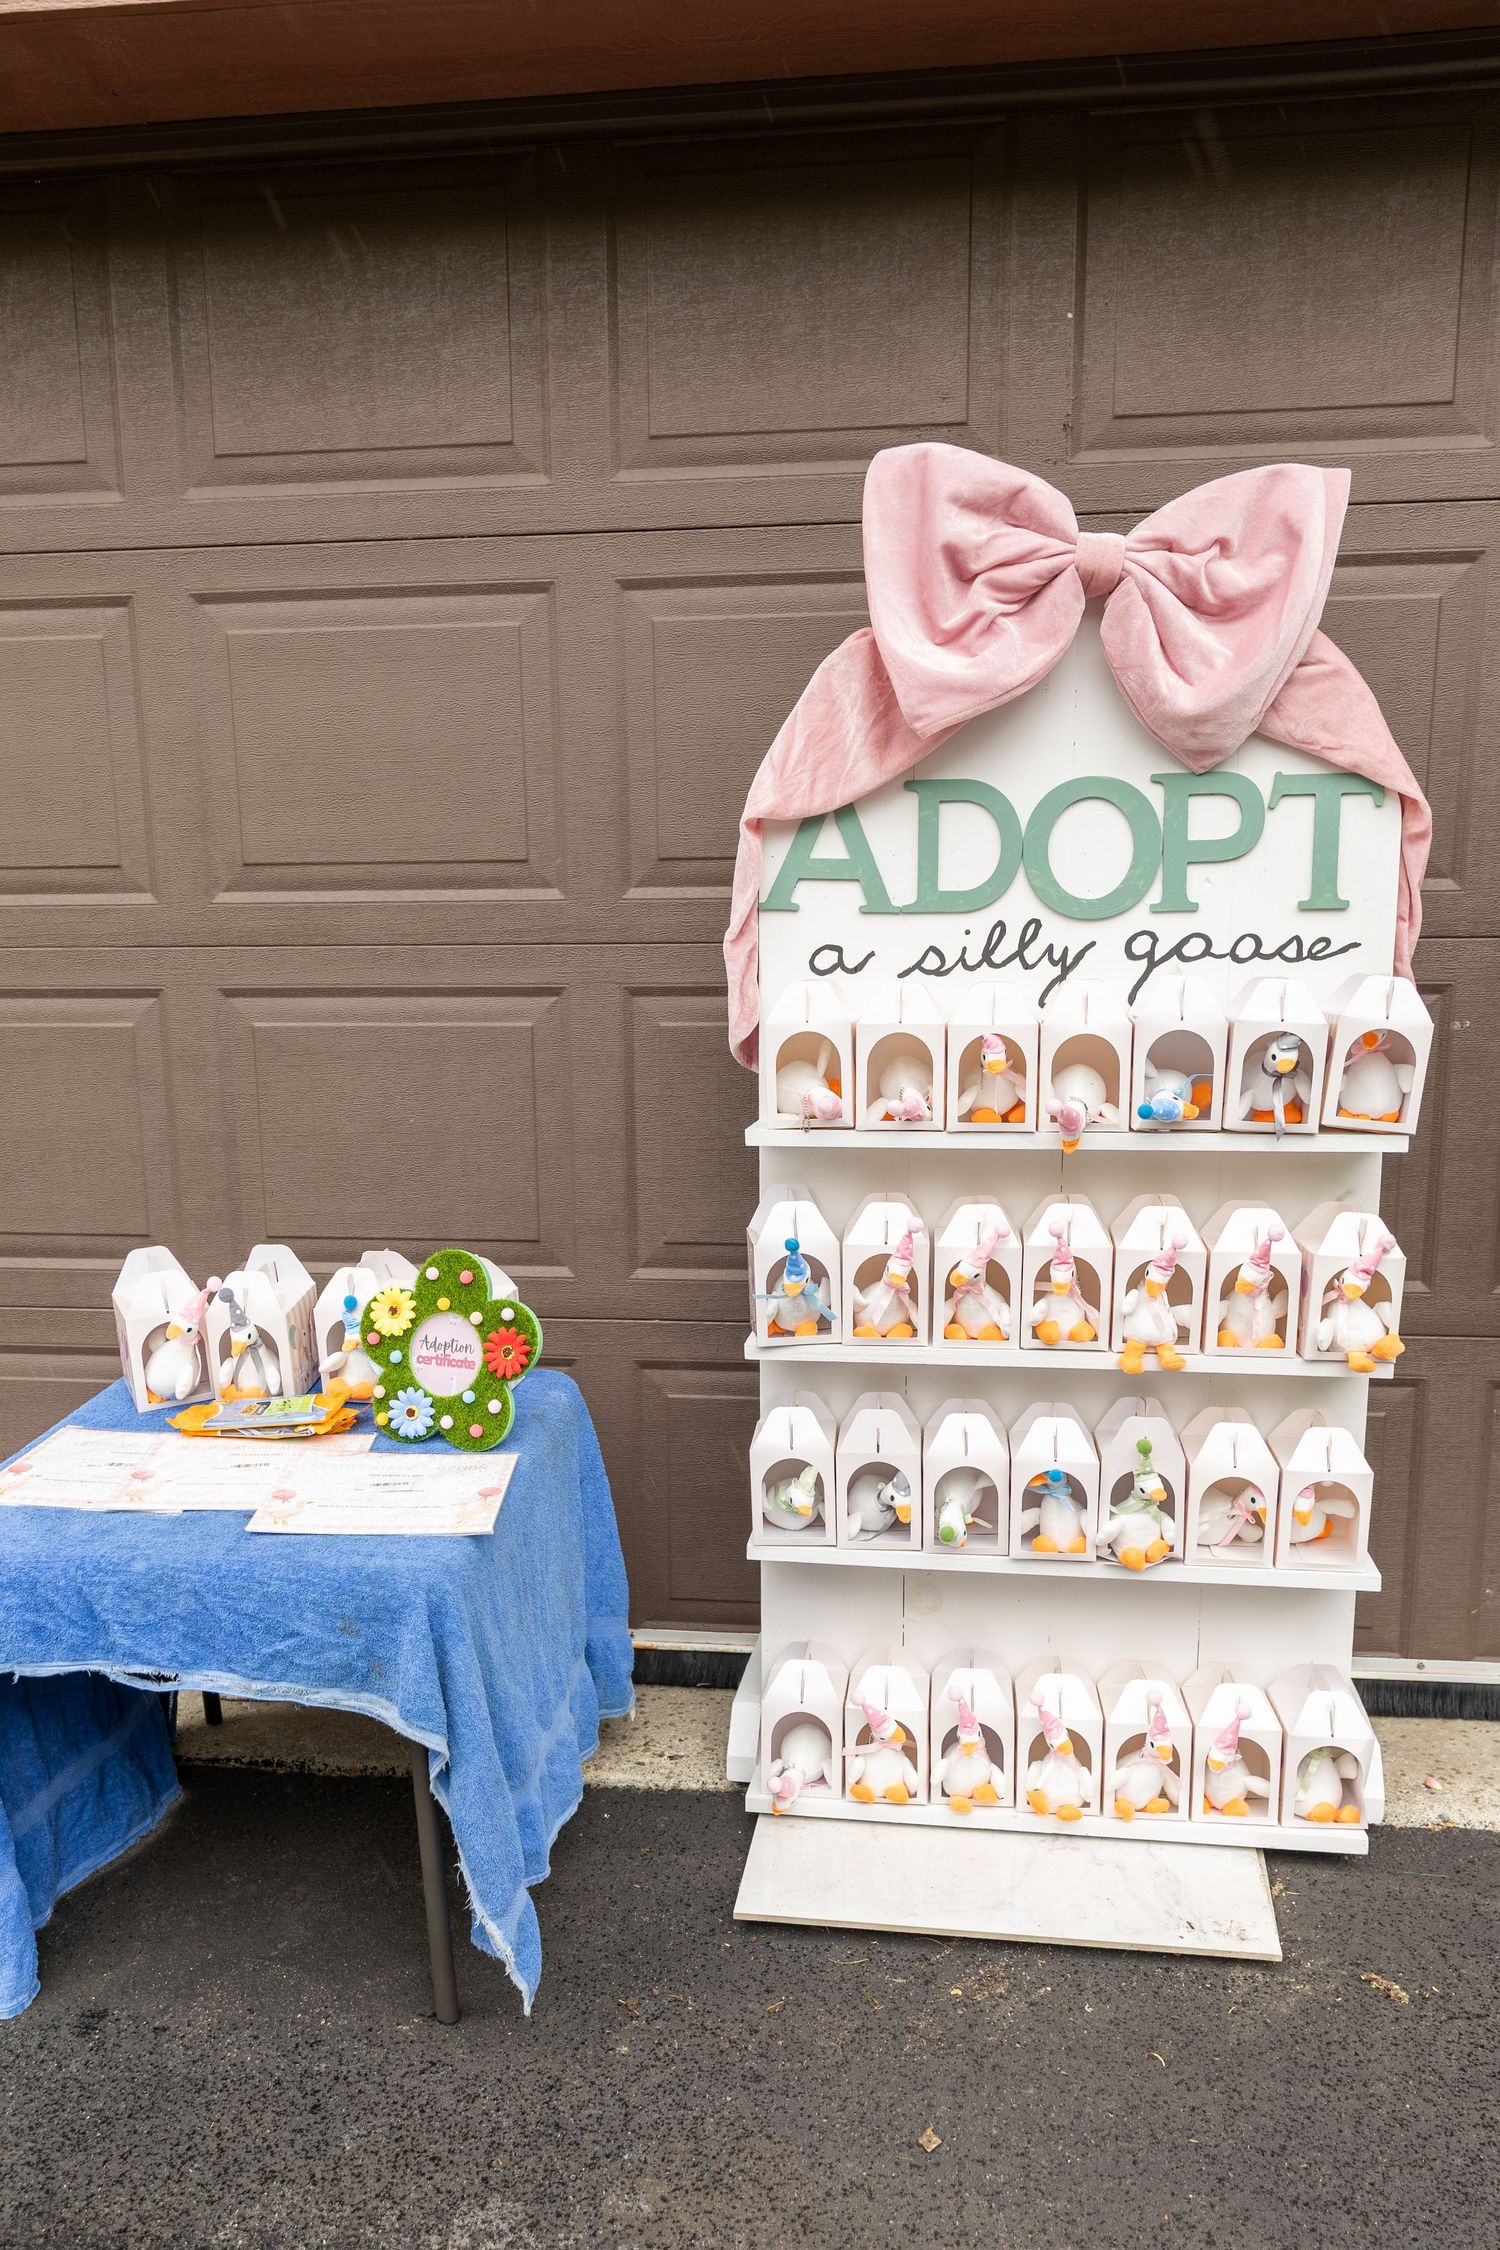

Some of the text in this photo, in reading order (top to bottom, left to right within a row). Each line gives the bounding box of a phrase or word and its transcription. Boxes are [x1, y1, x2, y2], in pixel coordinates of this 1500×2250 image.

[758, 771, 1385, 920] ADOPT
[808, 918, 1362, 1009] a silly goose
[416, 1353, 476, 1370] certificate
[419, 1333, 475, 1355] Adoption
